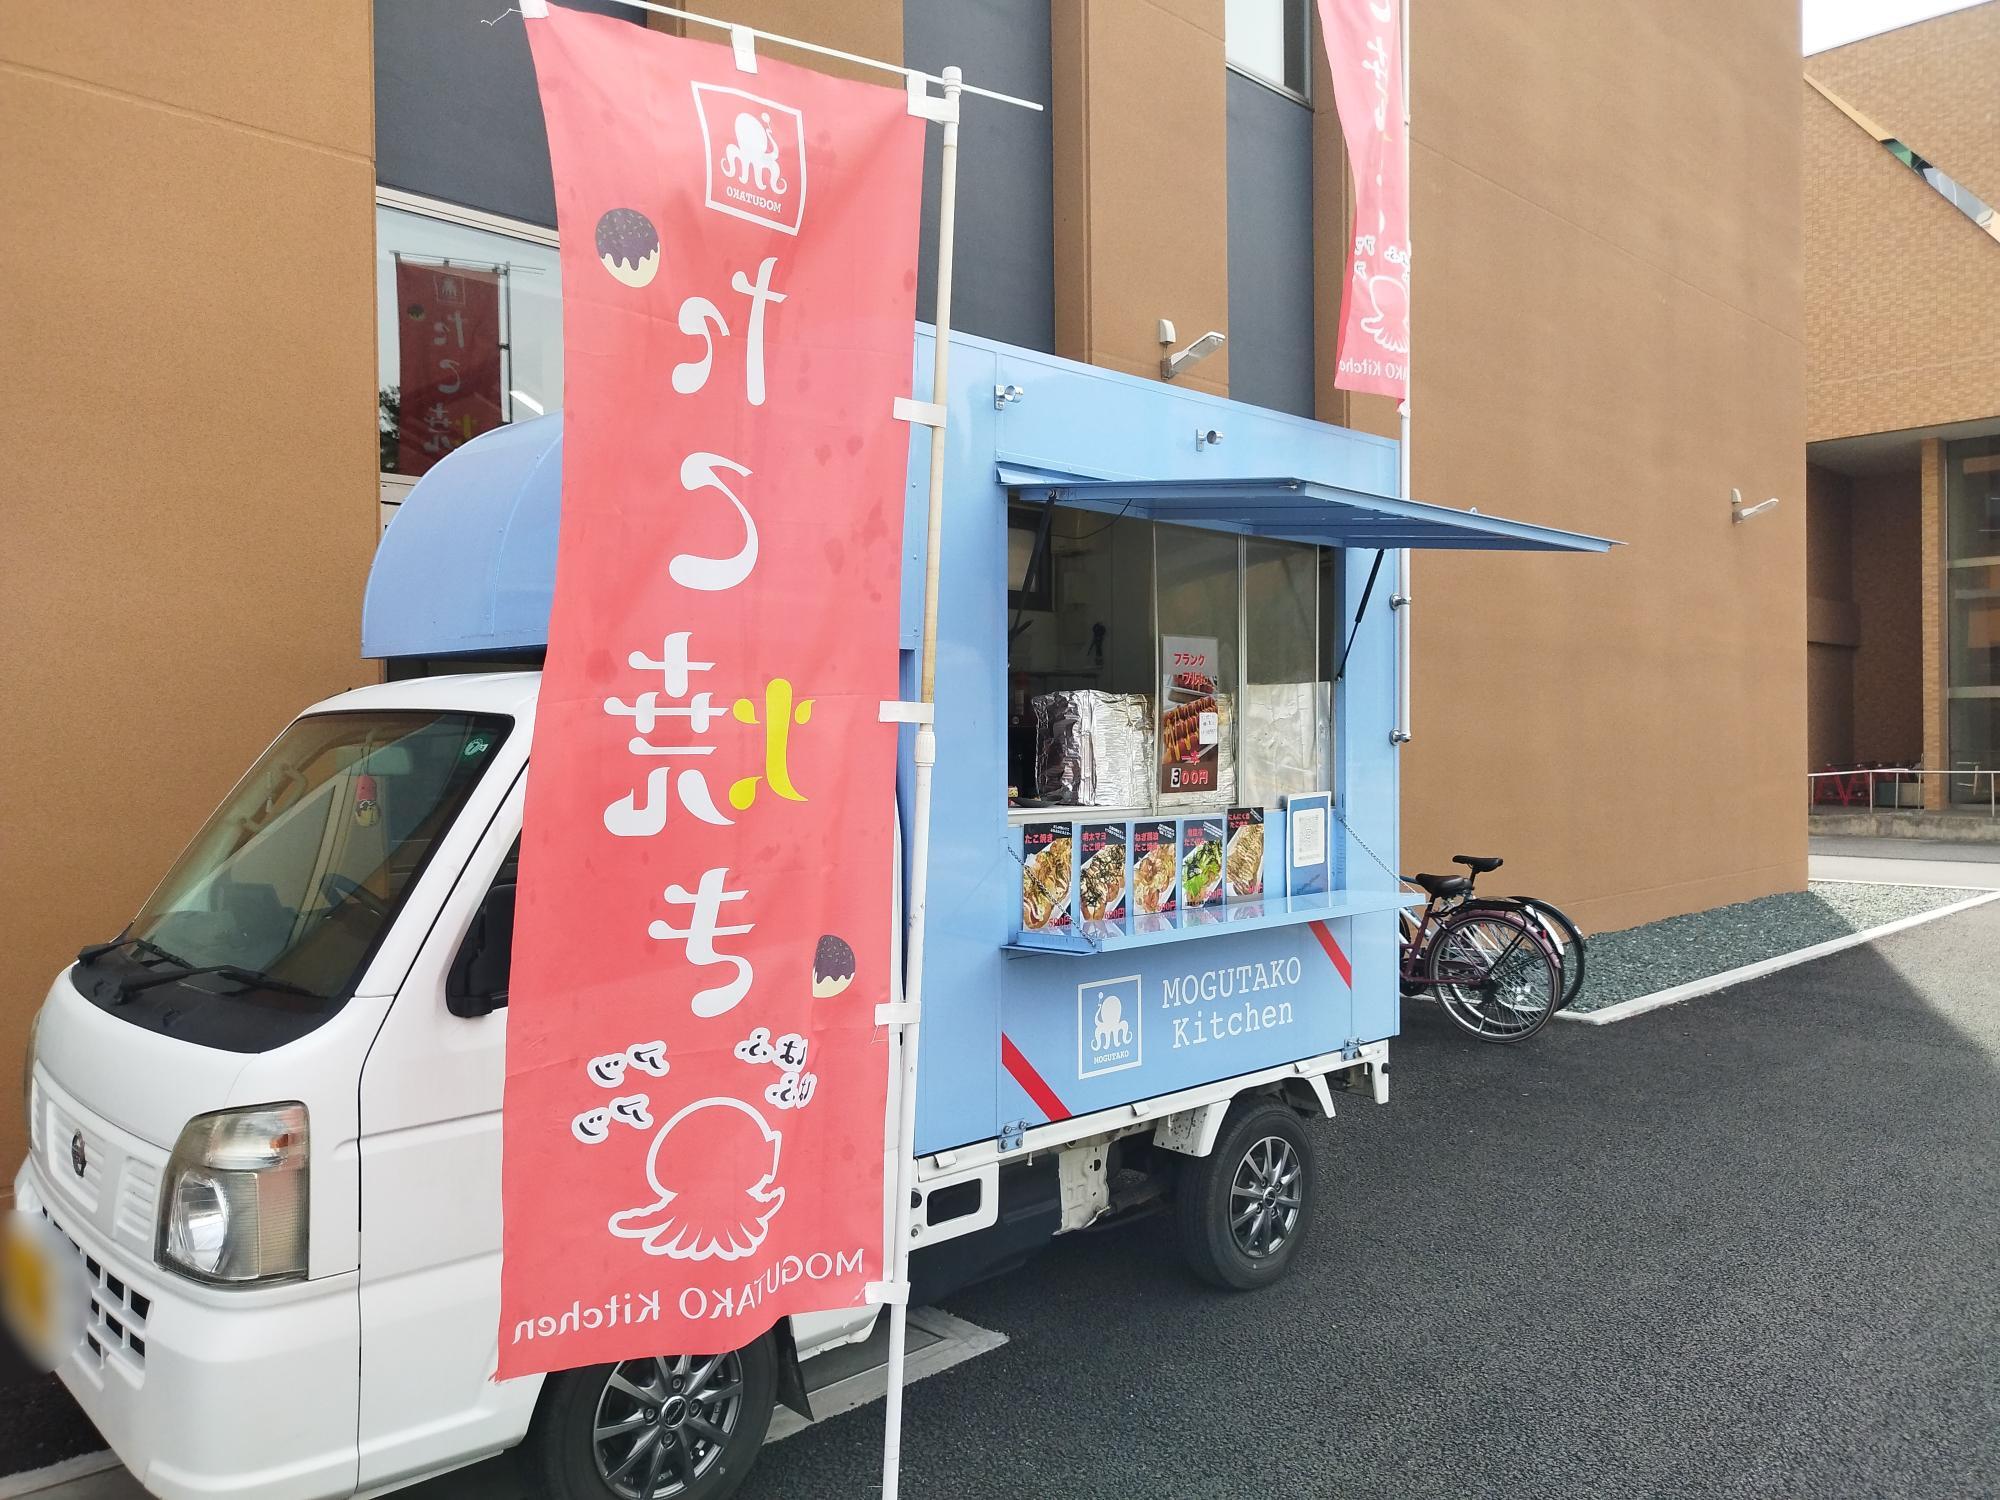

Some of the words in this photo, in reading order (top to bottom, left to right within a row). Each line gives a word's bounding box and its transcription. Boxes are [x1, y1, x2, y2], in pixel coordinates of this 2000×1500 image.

[1173, 653, 1205, 668] フランク
[1172, 768, 1208, 785] 300円
[1025, 833, 1054, 845] たこ焼き
[1082, 832, 1107, 842] 明太マヨ
[1162, 957, 1301, 1009] MOGUTAKO
[1172, 1002, 1293, 1048] Kitchen
[1093, 1051, 1129, 1065] MOGUTAKO
